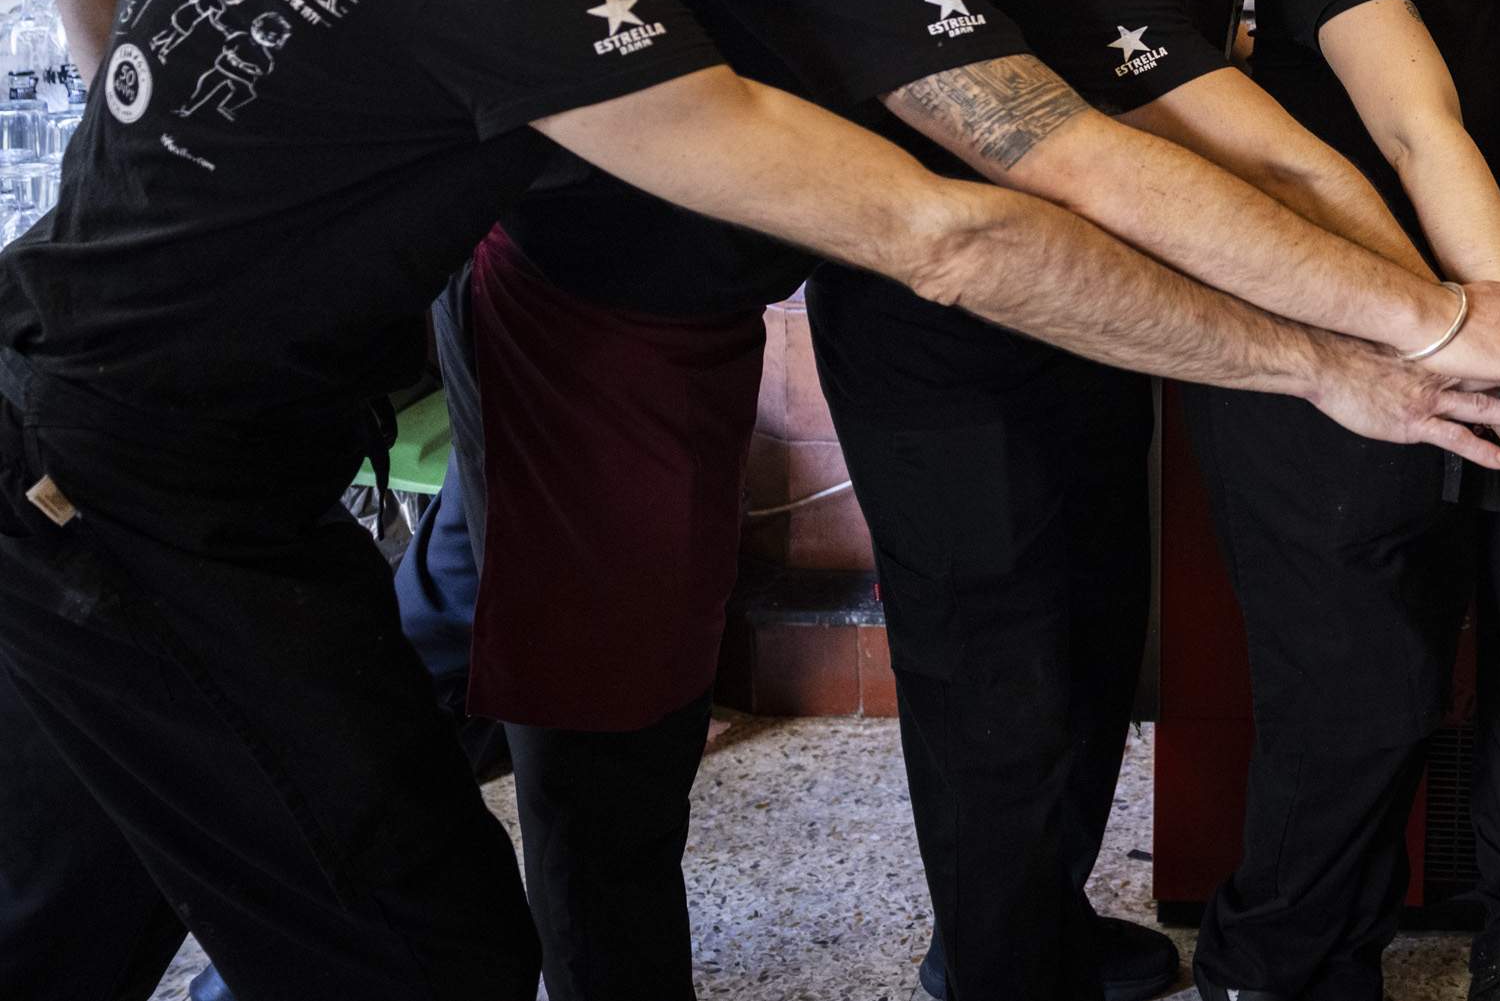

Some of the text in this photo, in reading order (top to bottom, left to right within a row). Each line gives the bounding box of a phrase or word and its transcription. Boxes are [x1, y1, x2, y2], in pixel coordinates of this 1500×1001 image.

[927, 14, 986, 36] ESTRELLA
[593, 22, 666, 55] ESTRELLA
[619, 38, 654, 56] DAMM
[1114, 46, 1168, 77] ESTRELLA
